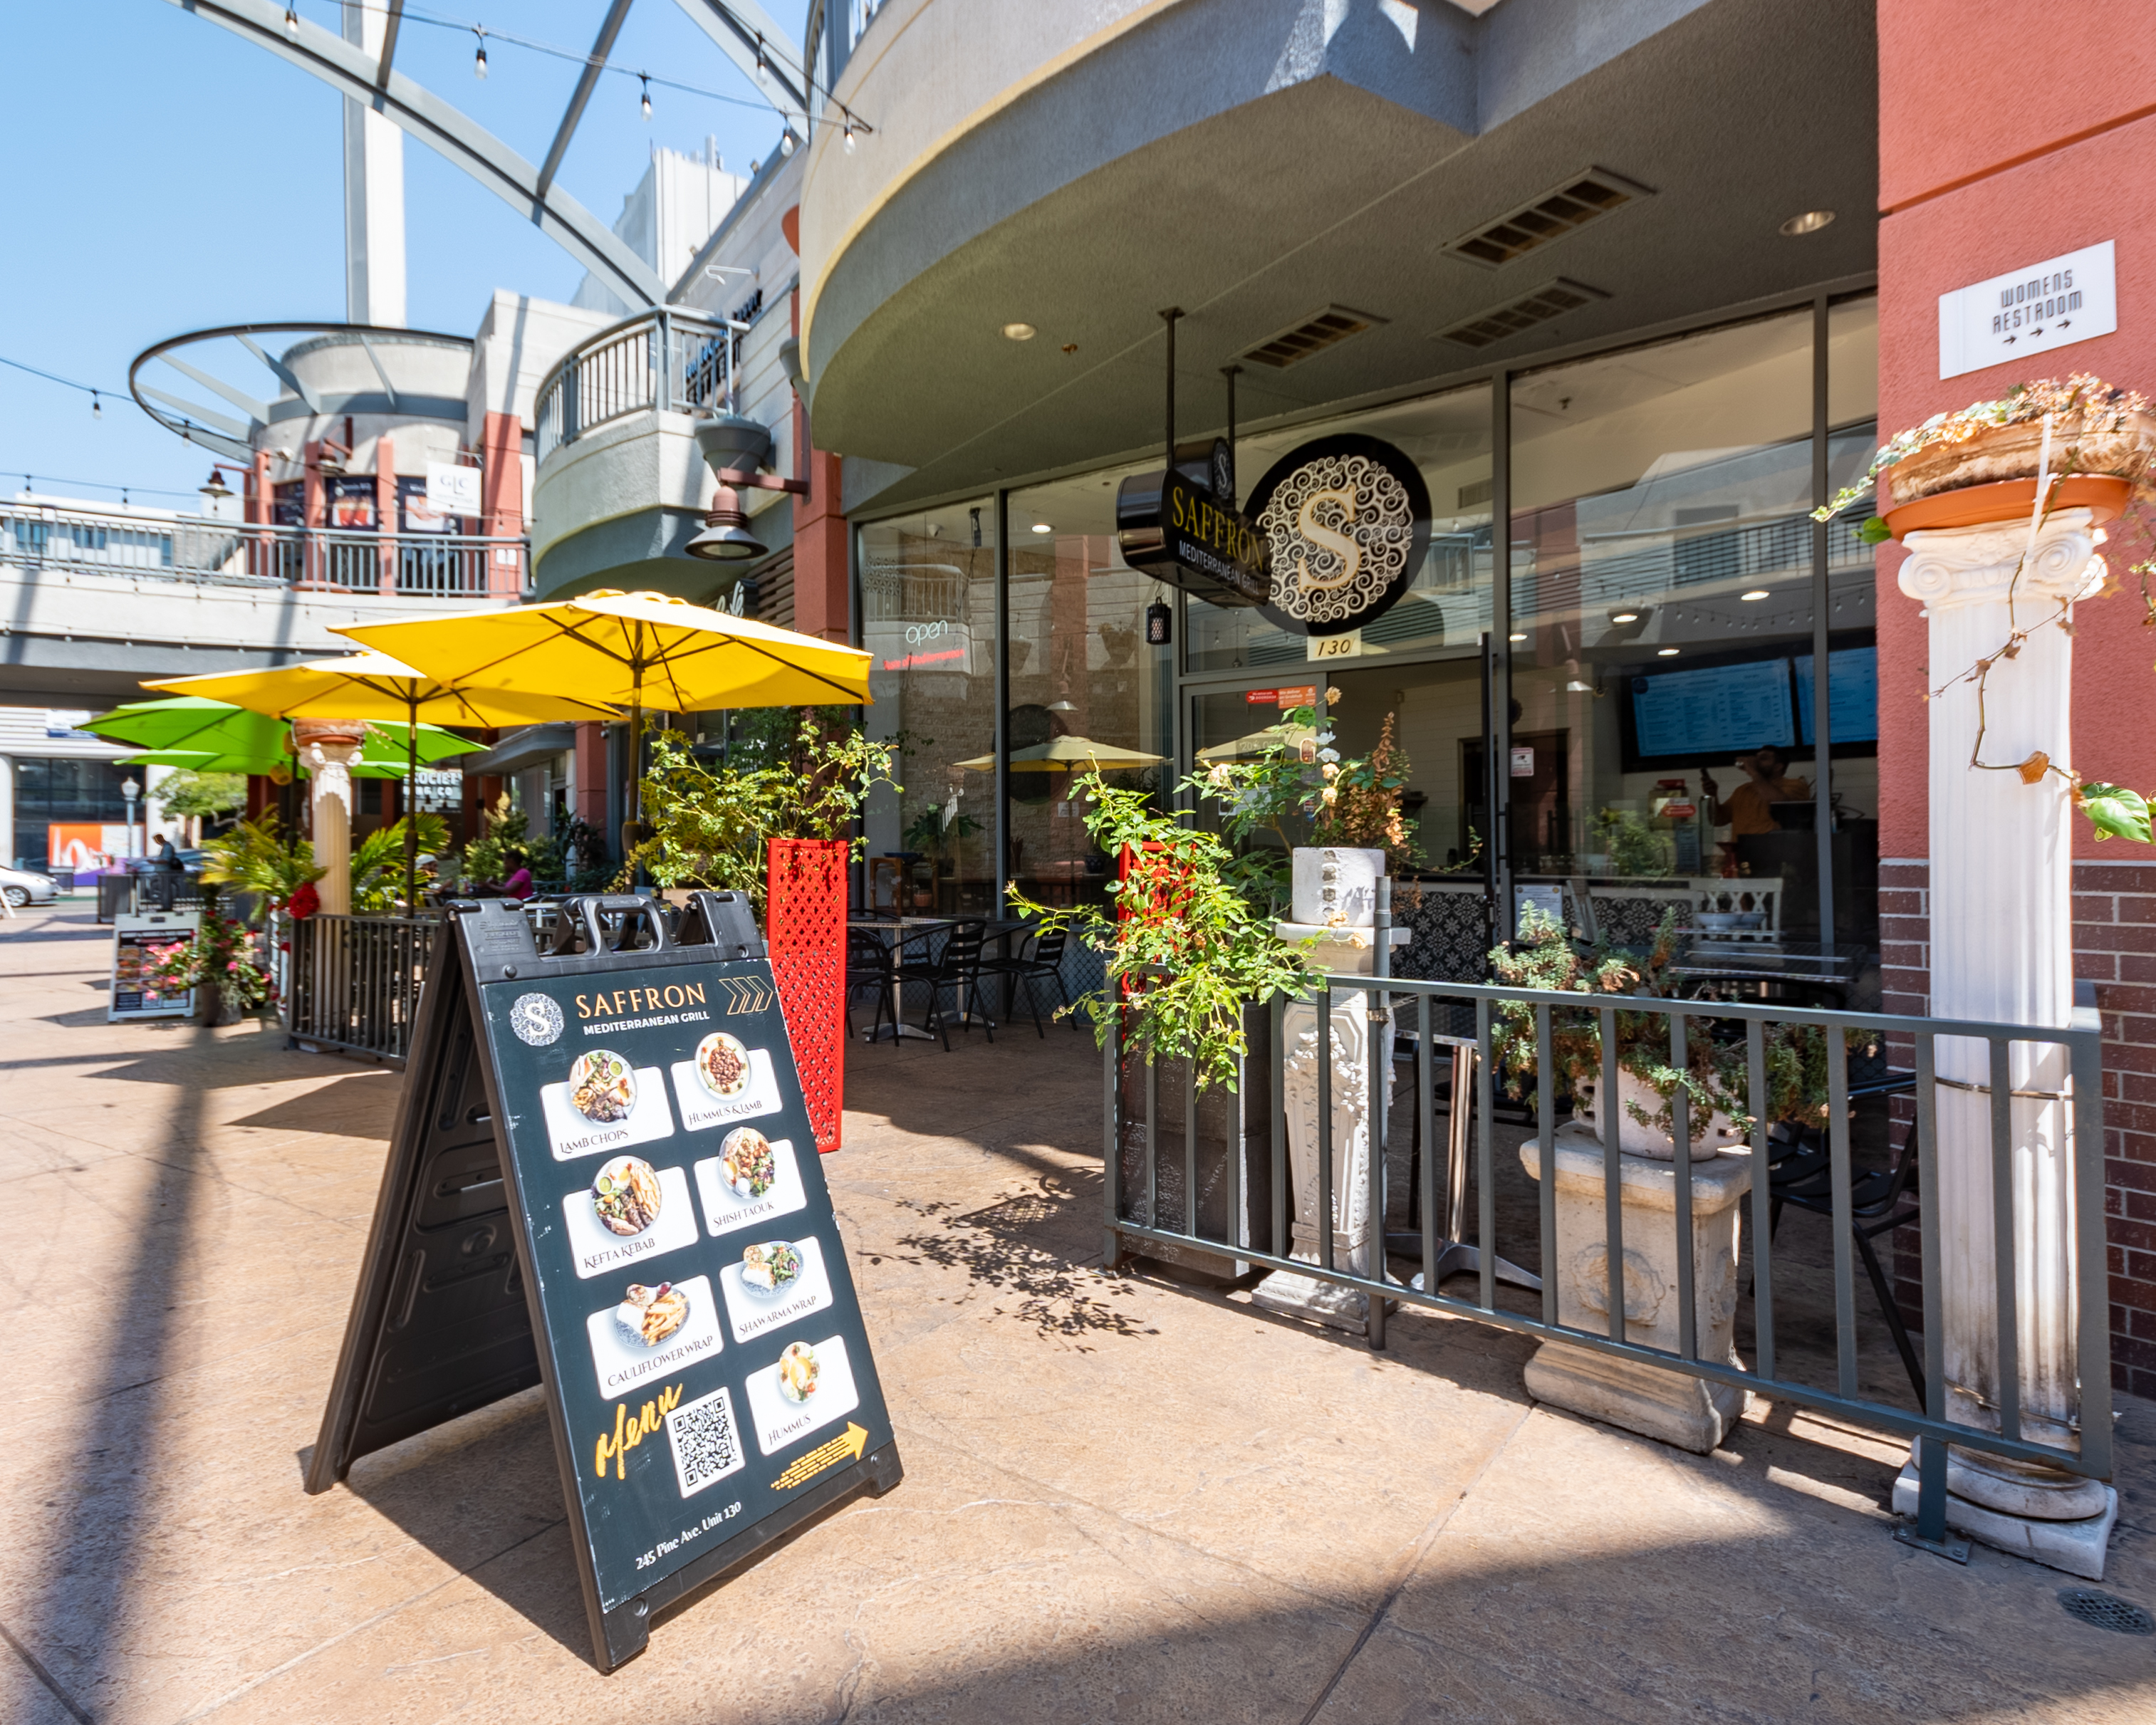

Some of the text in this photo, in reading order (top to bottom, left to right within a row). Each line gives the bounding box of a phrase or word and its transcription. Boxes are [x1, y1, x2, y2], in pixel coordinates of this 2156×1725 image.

[2001, 269, 2073, 308] WOMENS
[1993, 290, 2082, 334] RESTROOM
[1172, 486, 1265, 572] SAFFRON
[1298, 484, 1361, 593] S
[1179, 540, 1240, 585] MEDITERRANEAN
[1241, 574, 1260, 595] GRILL
[906, 620, 947, 647] open
[1318, 639, 1351, 657] 130
[576, 983, 707, 1019] SAFFRON
[525, 1002, 551, 1036] S
[583, 1010, 710, 1036] MEDITERRANEAN GRILL
[688, 1100, 763, 1125] HUMMUS & LAMB
[559, 1129, 628, 1154] LAMB CHOPS
[713, 1202, 774, 1229] SHISH TAOUK
[583, 1238, 655, 1269] KEFTA KEBAB
[739, 1295, 817, 1336] SHAWARMA WRAP
[607, 1335, 714, 1387] CAULIFLOWER WRAP
[595, 1382, 684, 1481] Menu
[768, 1413, 812, 1446] HUMMUS
[635, 1500, 742, 1570] 245 Pine Ave. Unit 130
